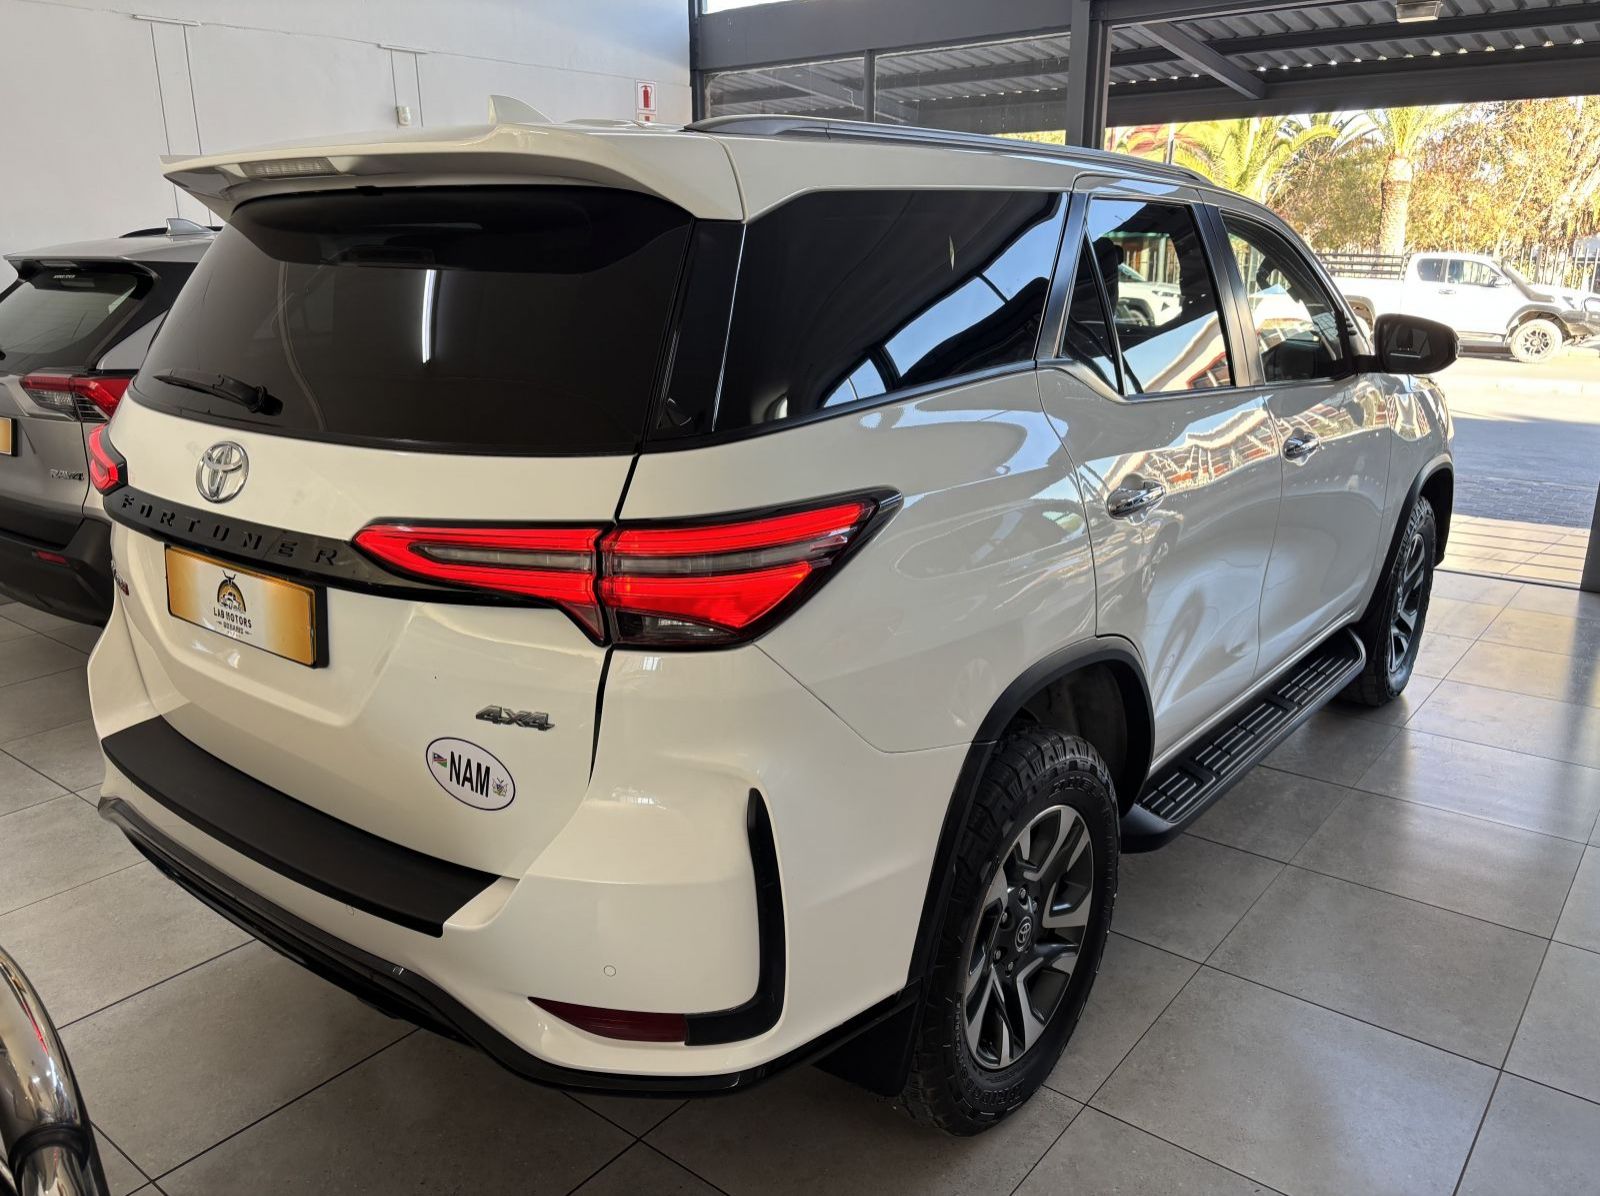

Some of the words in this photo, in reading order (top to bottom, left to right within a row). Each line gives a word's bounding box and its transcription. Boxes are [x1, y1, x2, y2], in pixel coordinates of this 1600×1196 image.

[121, 494, 338, 566] FORTUNER
[213, 606, 225, 619] LAB
[225, 610, 252, 629] MOTORS
[450, 751, 491, 798] NAM
